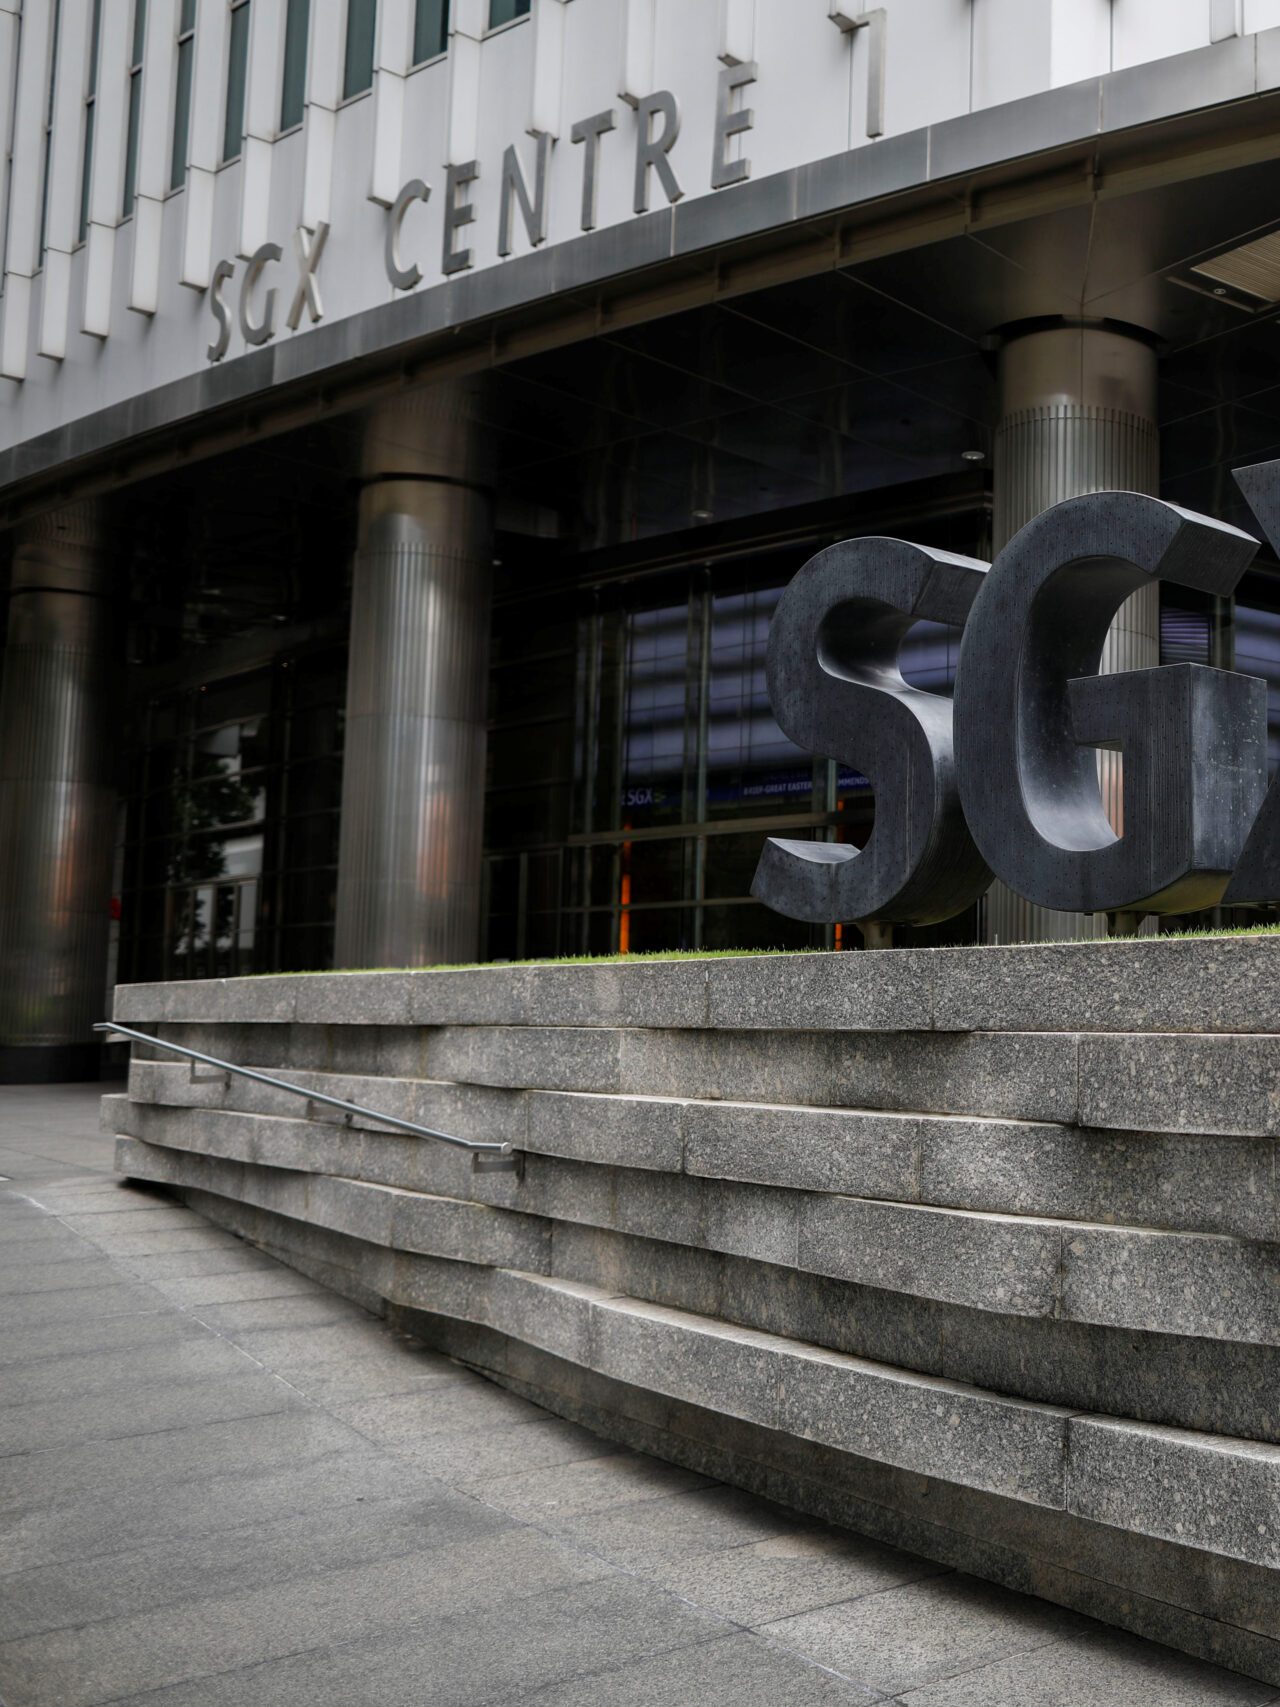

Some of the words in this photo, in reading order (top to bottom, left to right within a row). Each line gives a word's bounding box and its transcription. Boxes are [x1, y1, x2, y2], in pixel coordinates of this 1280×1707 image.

[207, 220, 330, 362] SGX
[384, 61, 758, 291] CENTRE
[787, 780, 814, 793] EASTER
[627, 787, 653, 806] SGX
